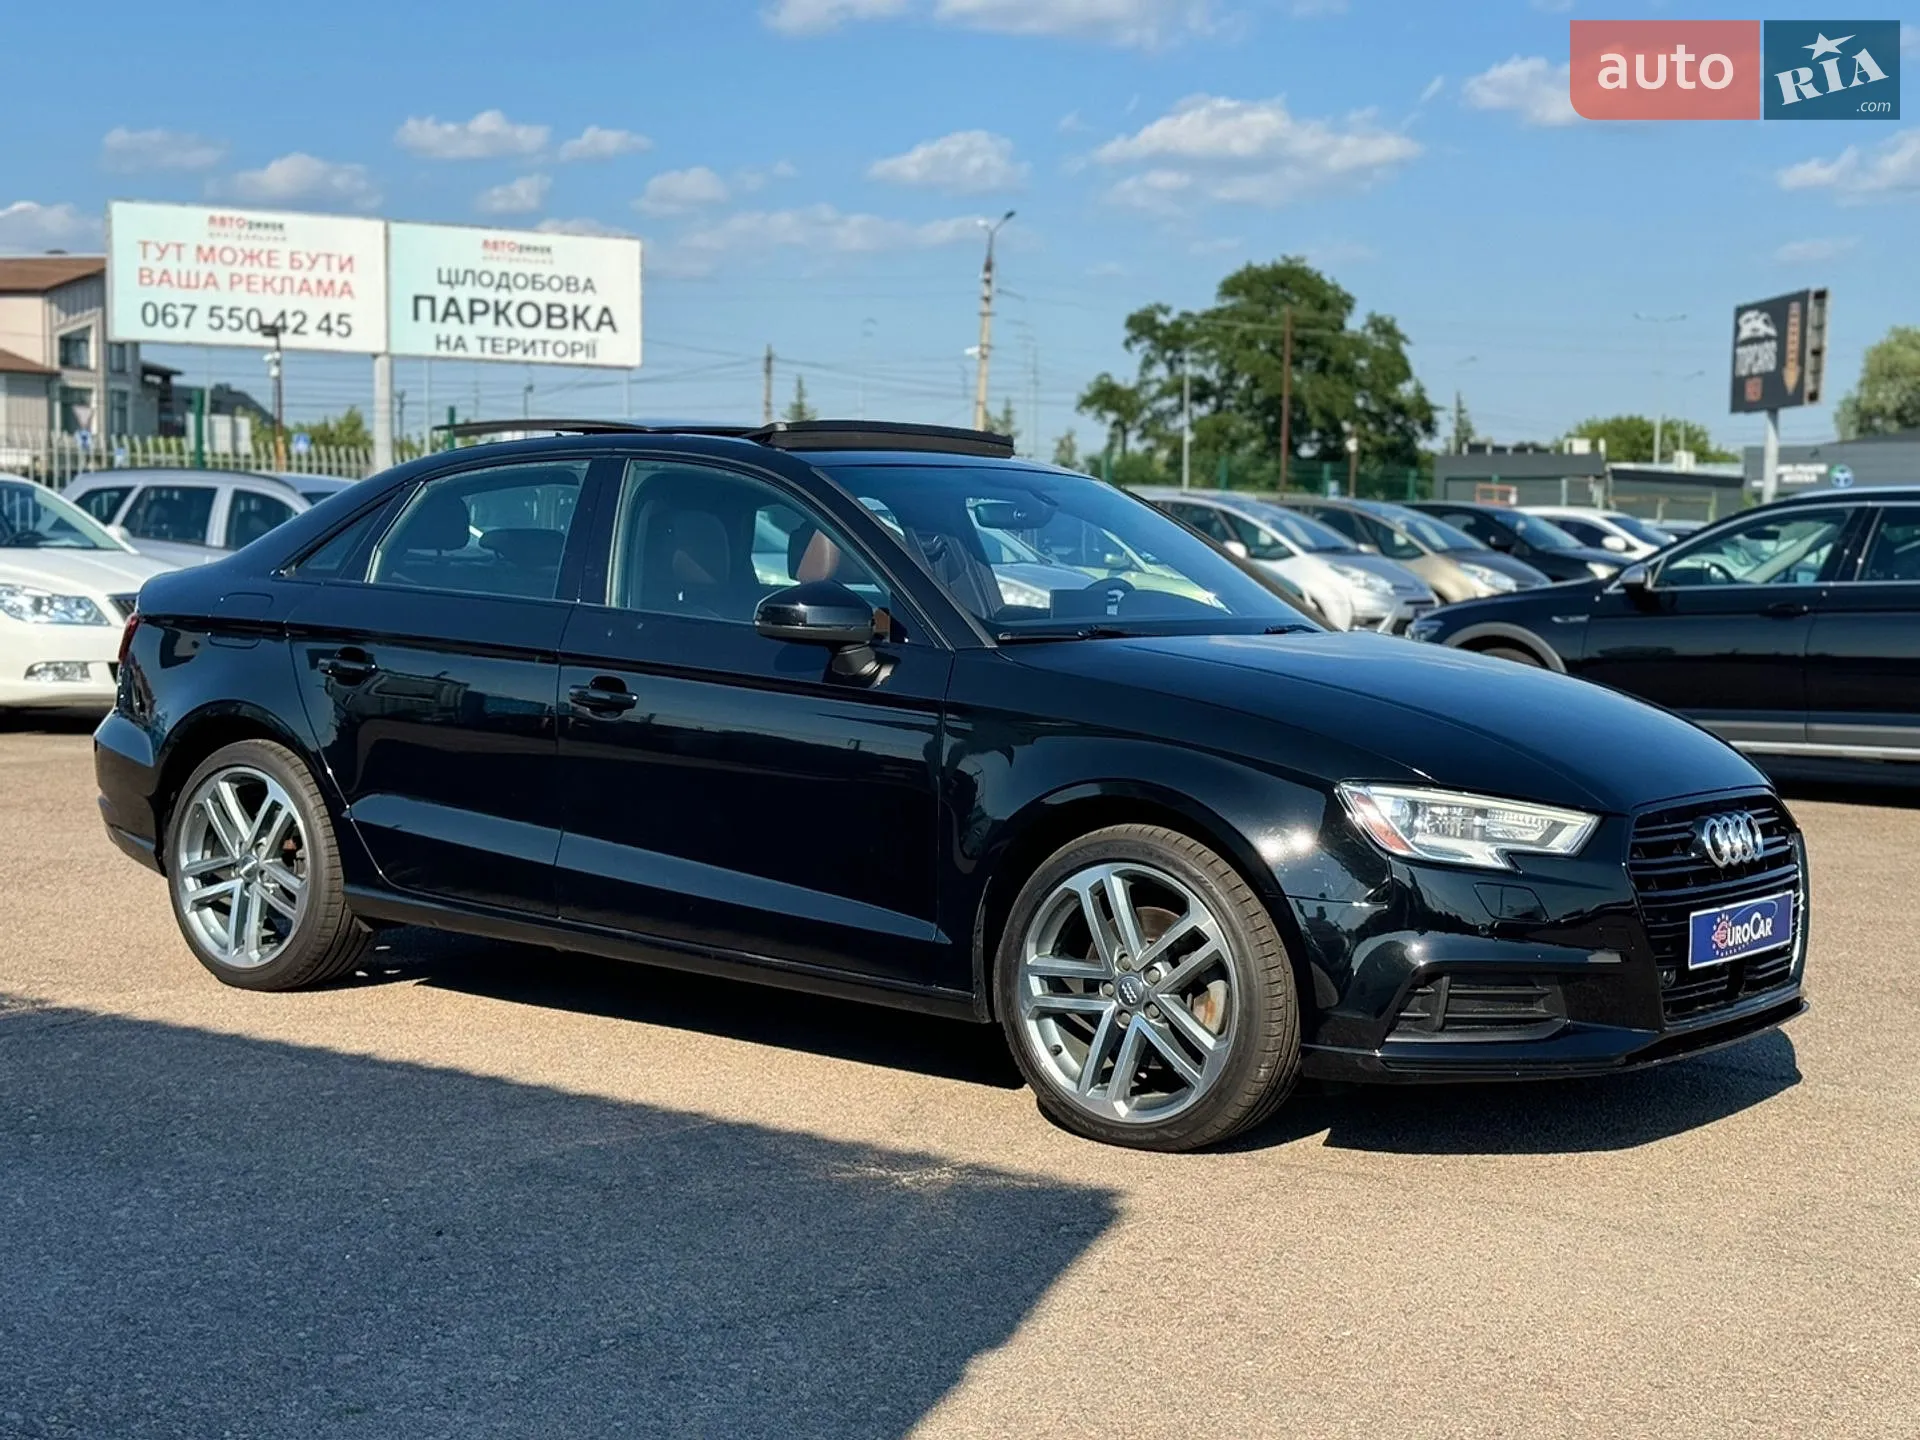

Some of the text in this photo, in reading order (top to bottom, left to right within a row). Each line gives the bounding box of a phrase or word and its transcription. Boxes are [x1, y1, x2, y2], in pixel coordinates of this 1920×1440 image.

[137, 239, 355, 274] ТУТ МОЖЕ БУТИ
[138, 267, 356, 299] ВАША РЕКЛАМА
[437, 267, 596, 294] ЦІЛОДОБОВА
[141, 301, 353, 339] 067 550 42 45
[412, 294, 618, 333] ПАРКОВКА
[435, 334, 597, 359] НА ТЕРИТОРІЇ
